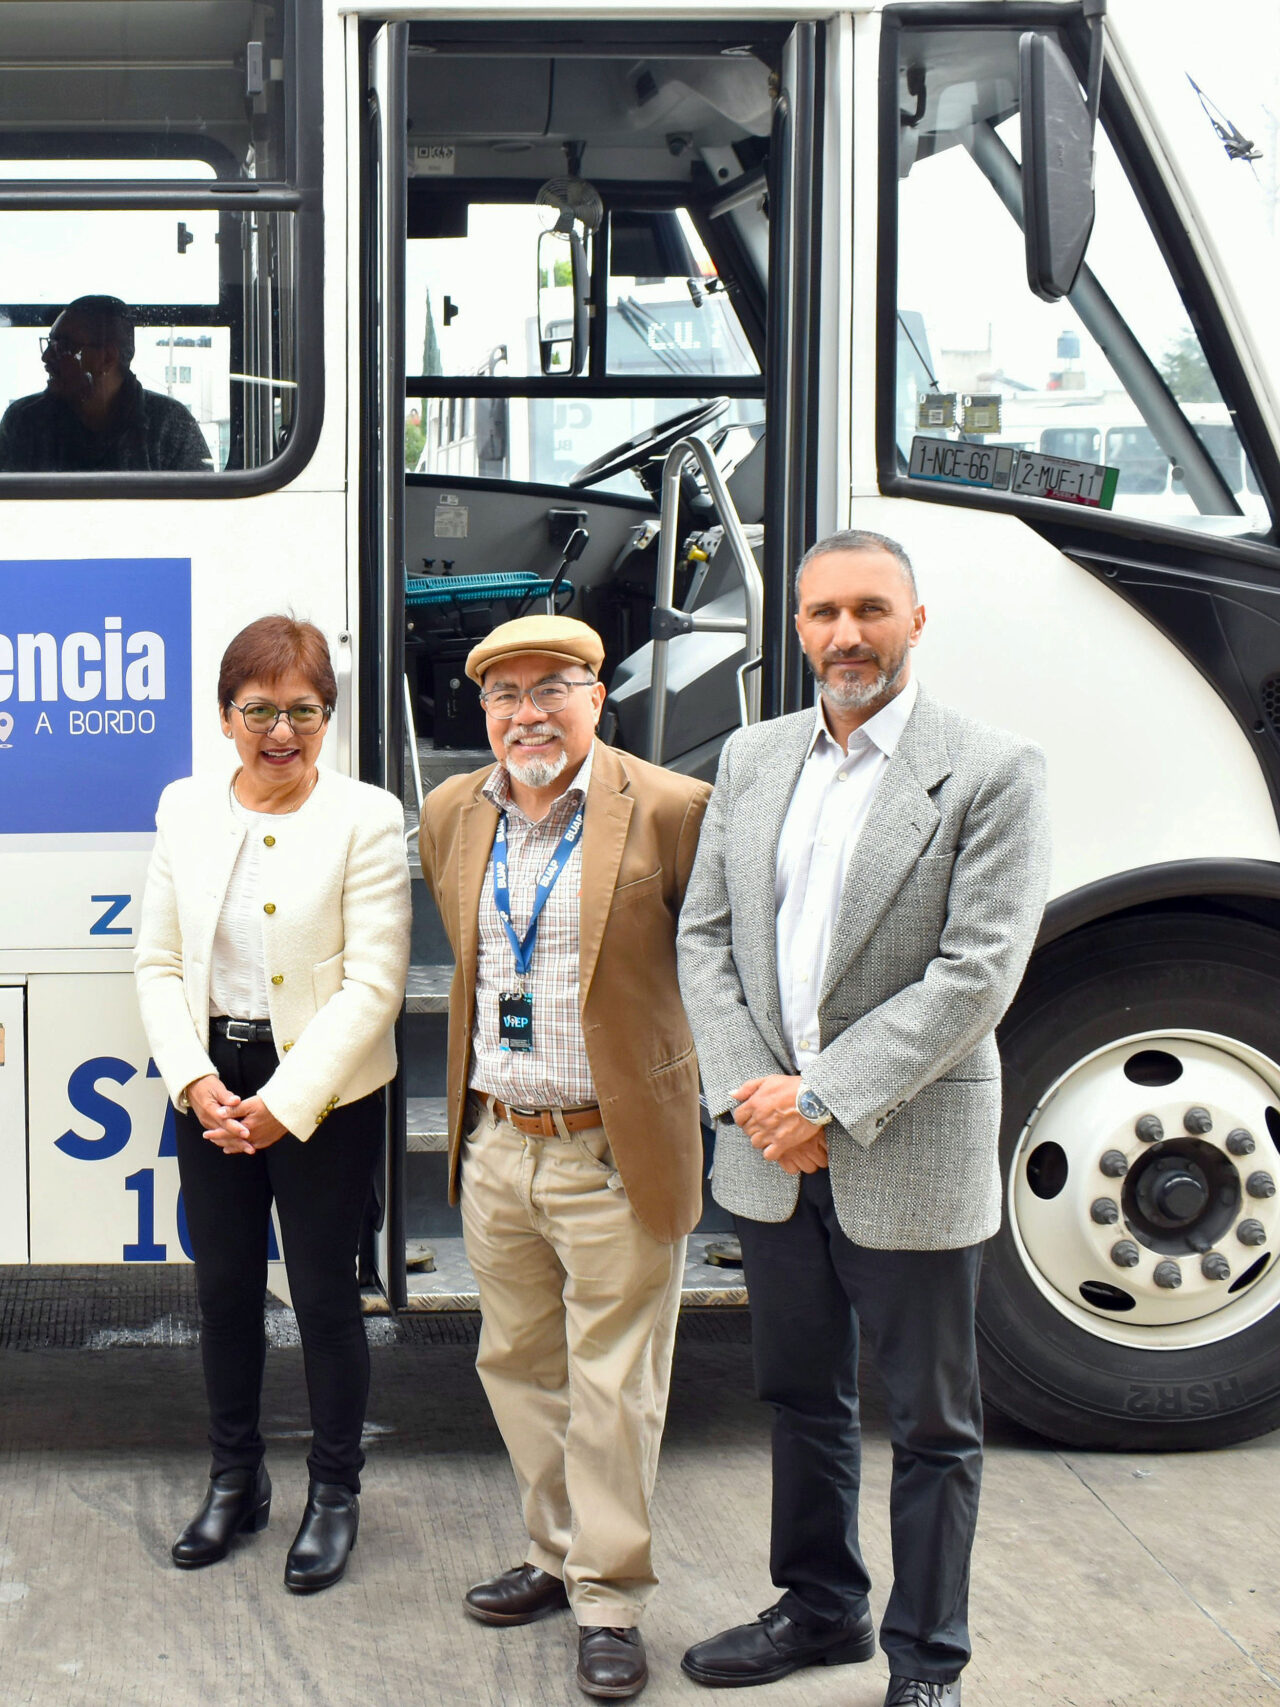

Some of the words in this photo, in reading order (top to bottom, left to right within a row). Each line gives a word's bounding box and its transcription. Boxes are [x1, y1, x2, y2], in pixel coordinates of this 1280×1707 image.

[920, 445, 991, 481] 1-NCE-66
[1022, 462, 1096, 497] 2-MUF-11
[34, 711, 53, 735] A
[69, 709, 156, 735] BORDO
[564, 813, 583, 842] BUAP
[496, 861, 507, 889] BUAP
[539, 859, 559, 888] BUAP
[1126, 1376, 1246, 1416] HSR2
